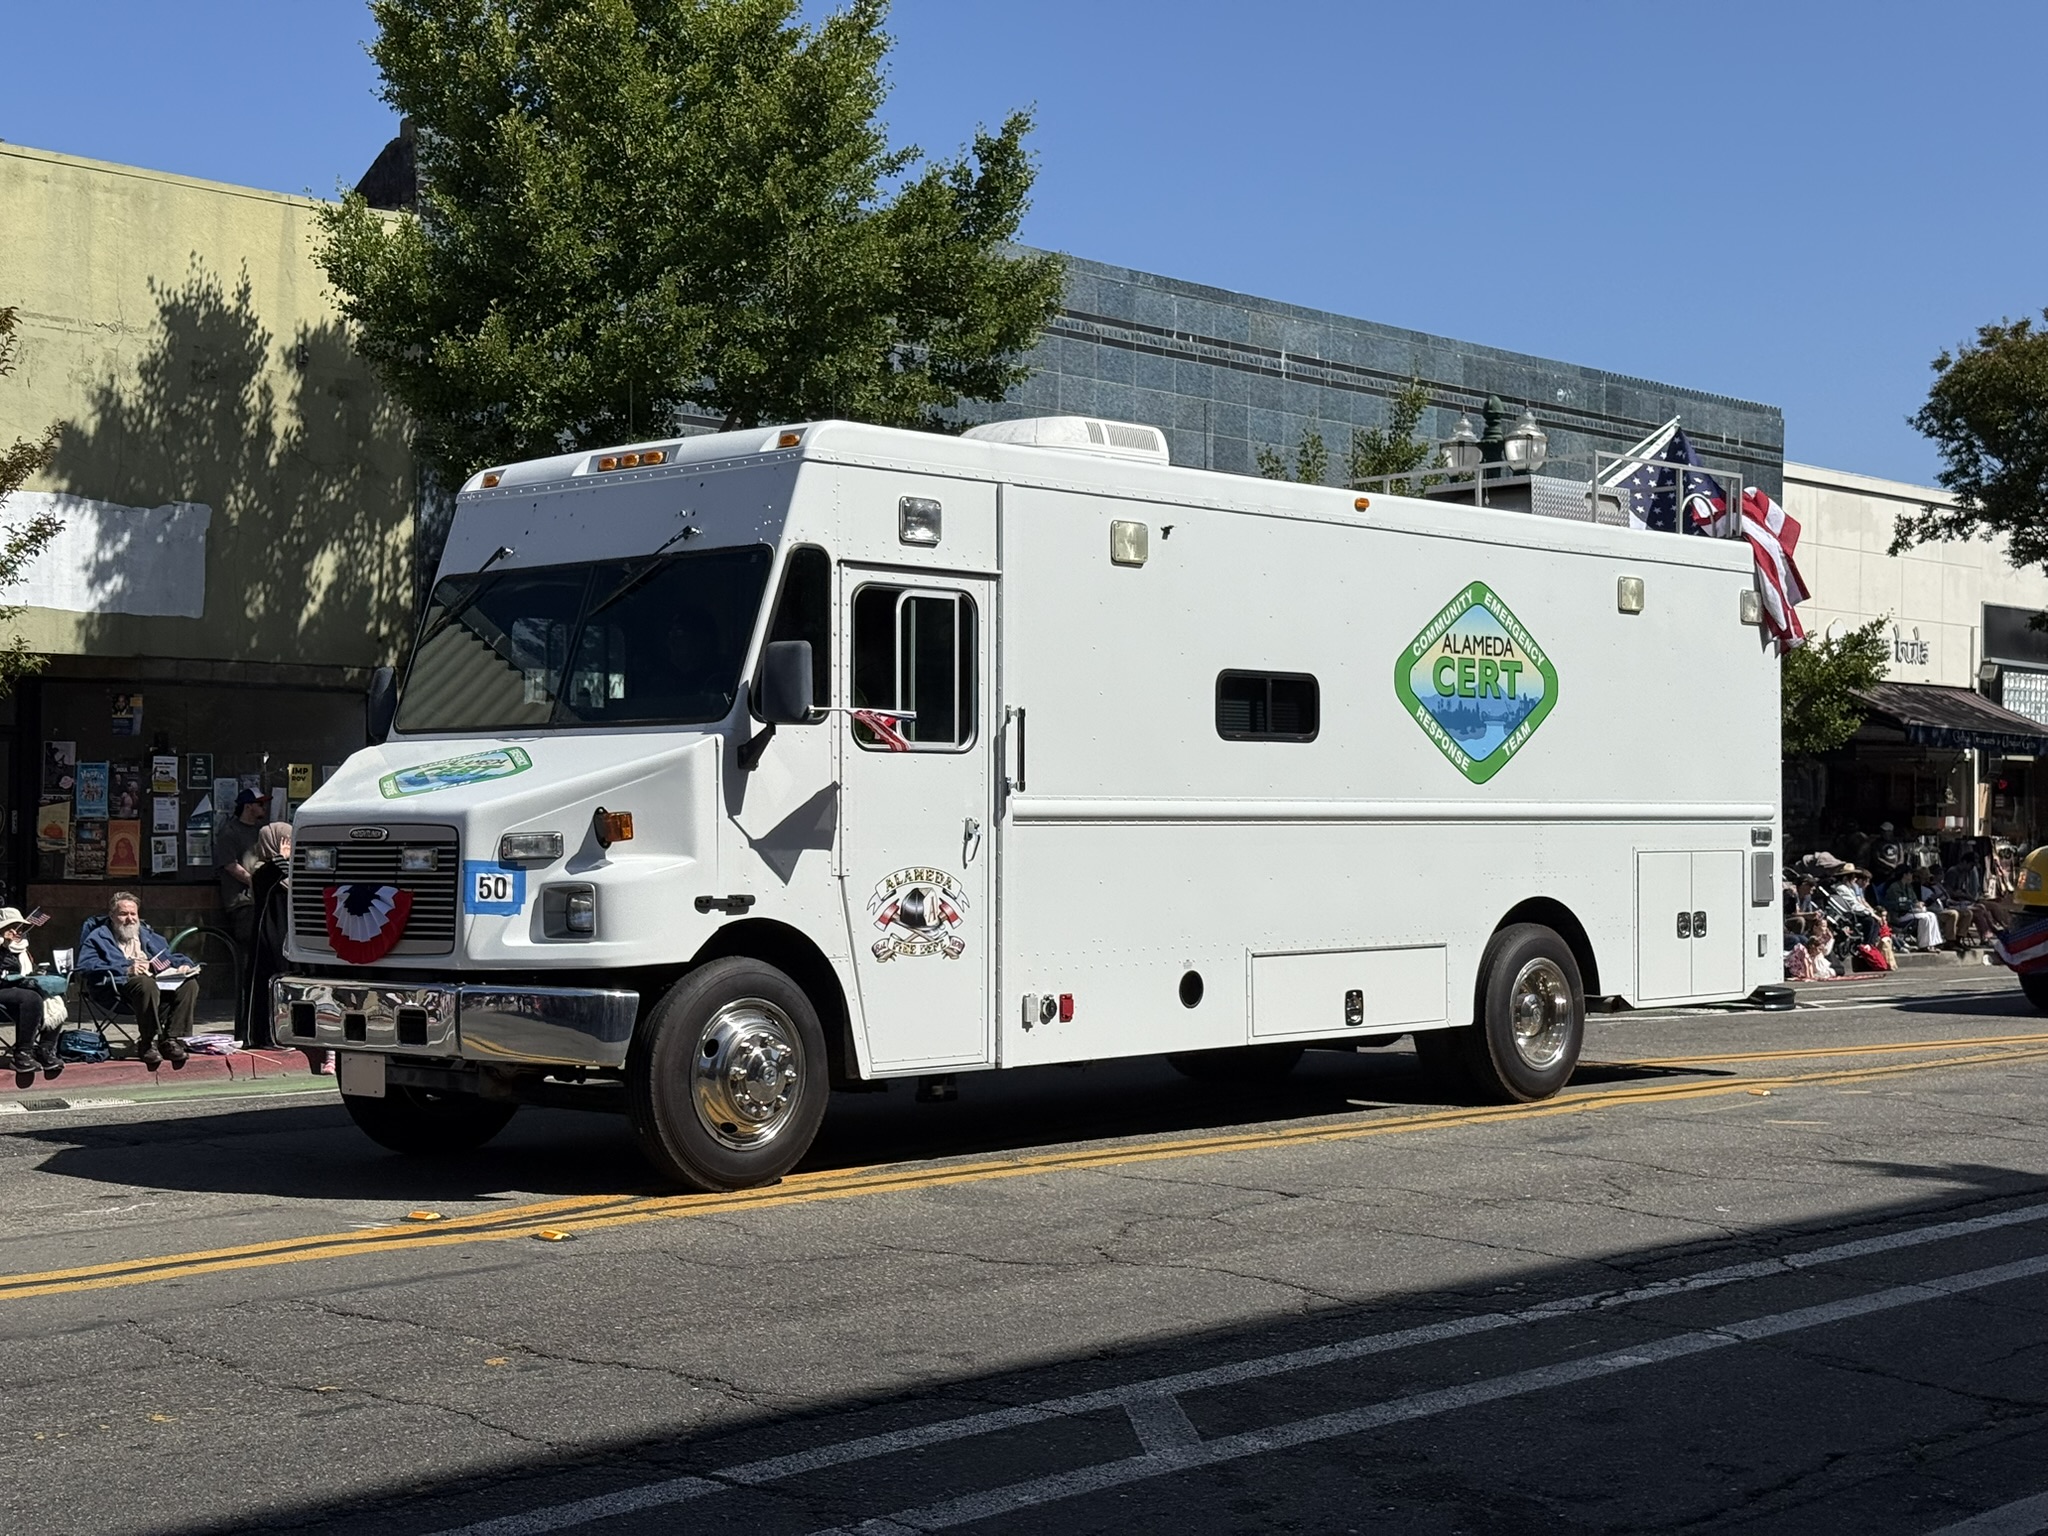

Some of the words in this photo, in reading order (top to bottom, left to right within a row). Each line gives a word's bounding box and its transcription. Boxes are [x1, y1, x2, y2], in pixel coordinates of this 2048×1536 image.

[1412, 589, 1473, 657] COMMUNITY
[1483, 592, 1546, 666] EMERGENCY
[1441, 633, 1515, 658] ALAMEDA
[1432, 655, 1523, 700] CERT
[1416, 705, 1471, 772] RESPONSE
[1502, 721, 1531, 756] TEAM
[292, 767, 309, 775] IMP
[479, 876, 507, 899] 50
[885, 868, 952, 893] ALAMEDA
